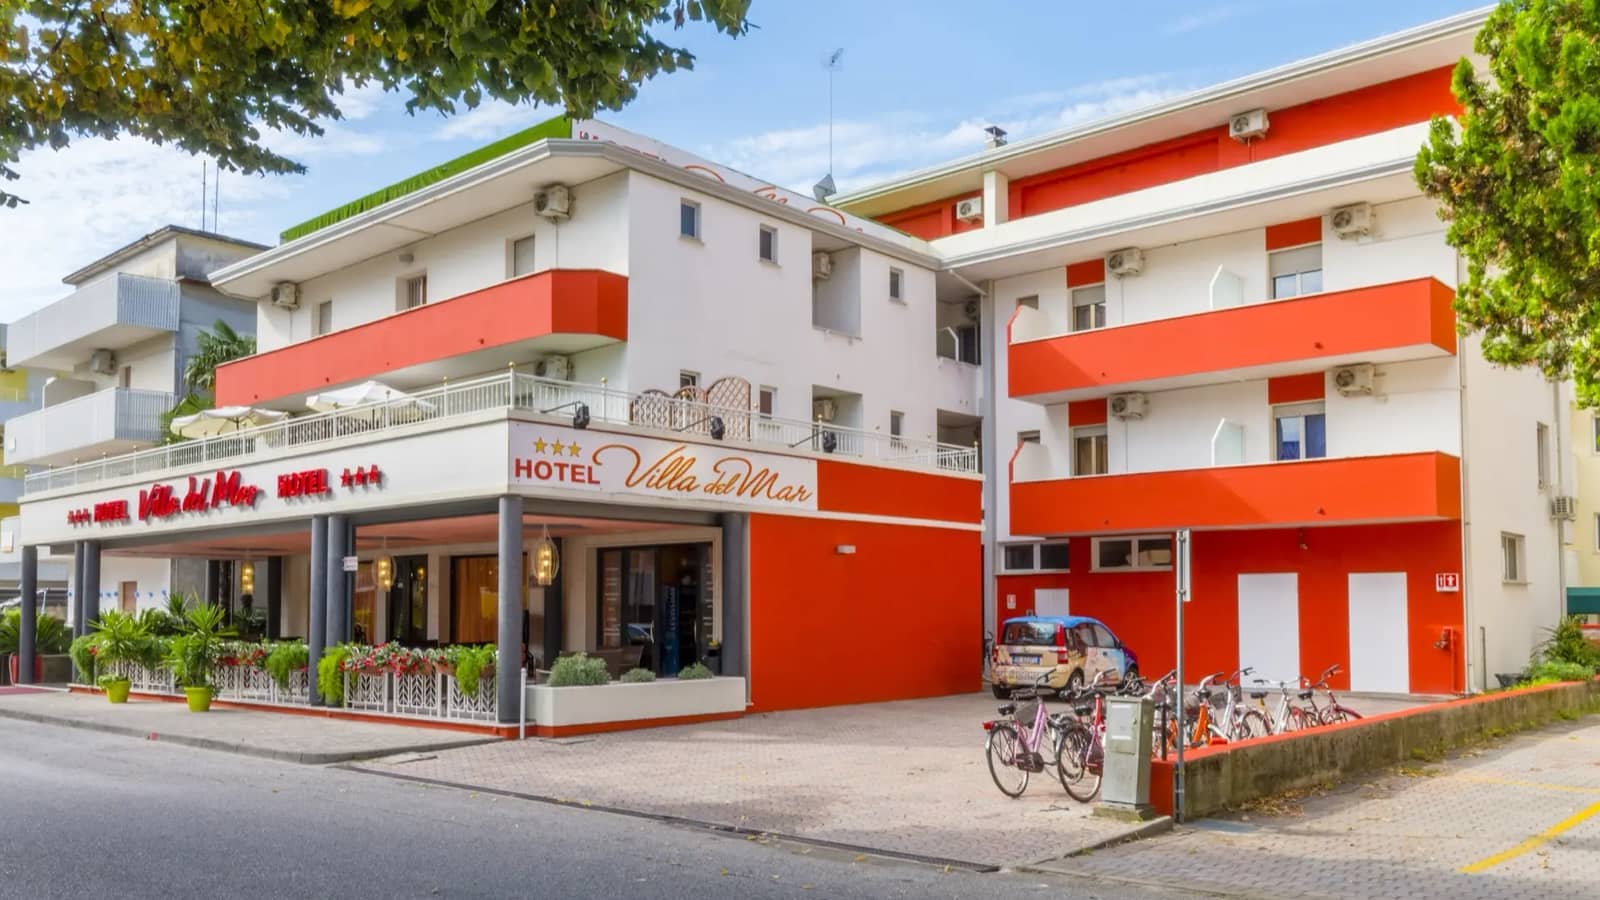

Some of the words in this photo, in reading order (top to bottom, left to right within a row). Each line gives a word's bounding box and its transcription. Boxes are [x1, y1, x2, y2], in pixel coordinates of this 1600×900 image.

[514, 457, 600, 485] HOTEL
[591, 443, 700, 492] Villa
[703, 471, 736, 496] del
[713, 456, 813, 502] Mar
[93, 500, 128, 523] HOTEL
[138, 484, 180, 521] Villa
[183, 475, 209, 512] del
[210, 469, 260, 509] Mar
[277, 468, 330, 498] HOTEL
